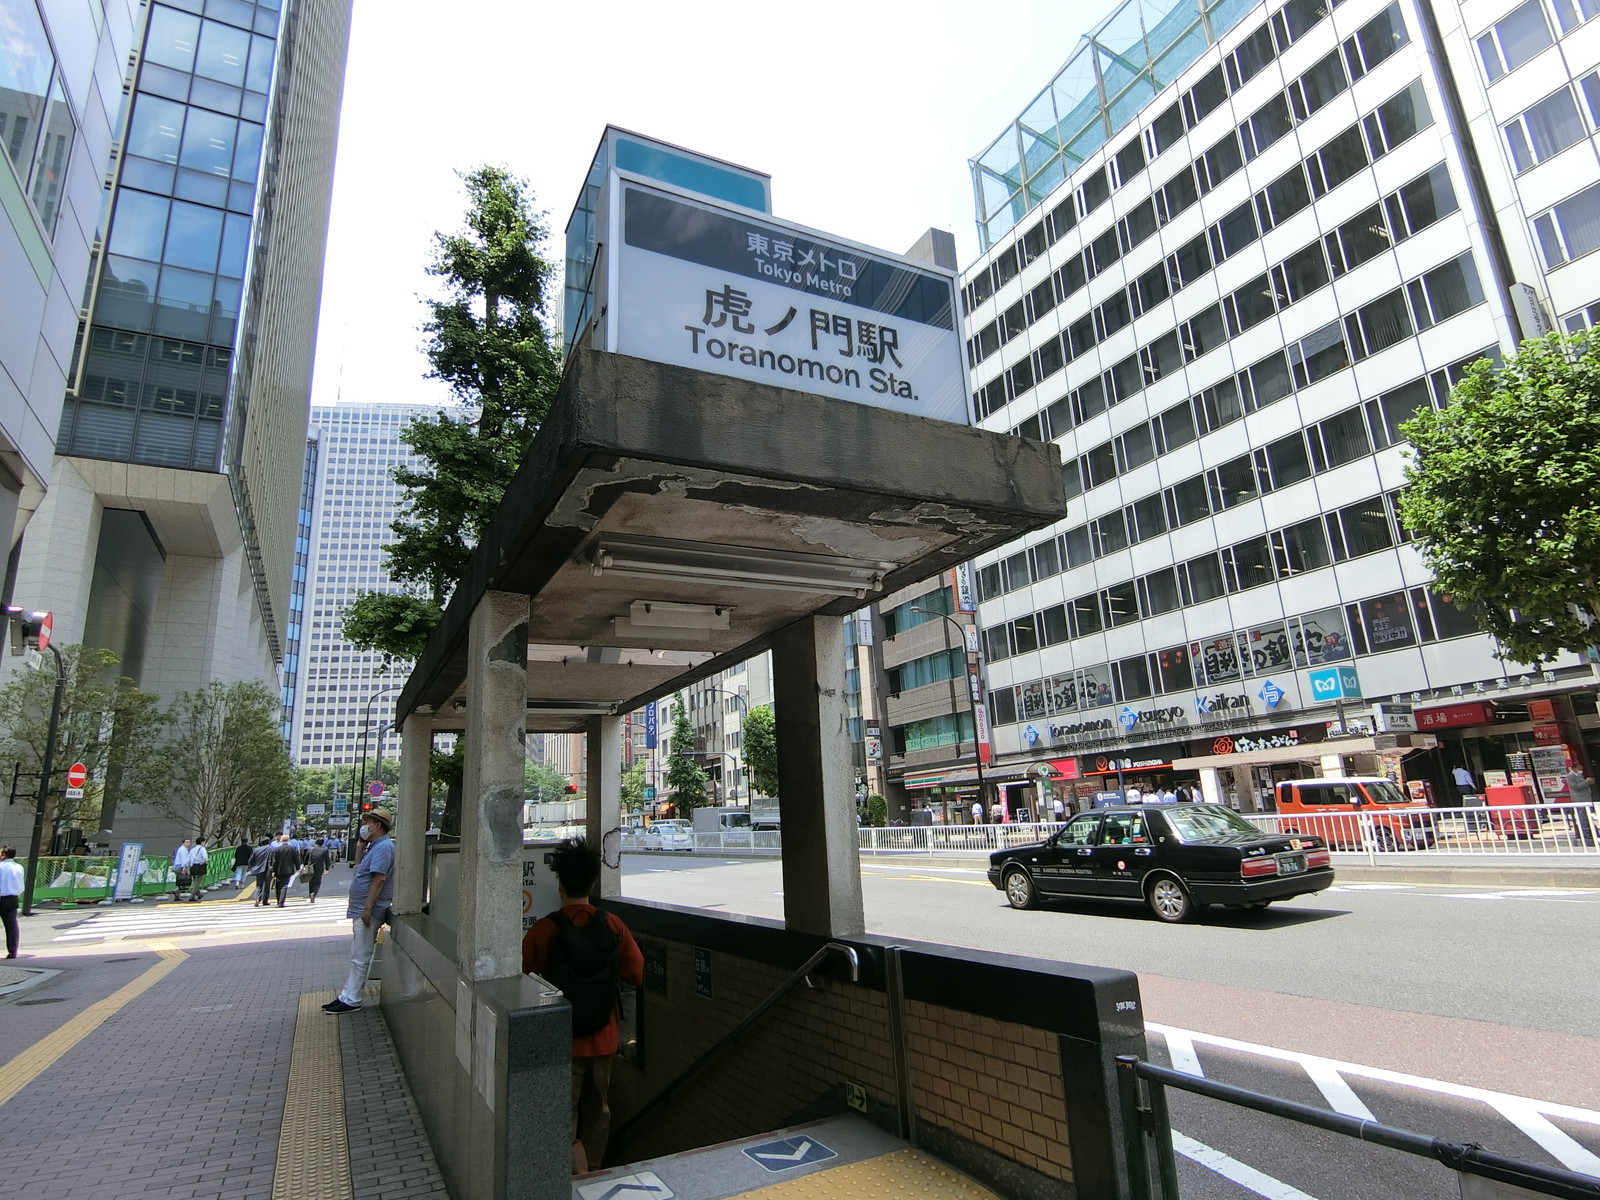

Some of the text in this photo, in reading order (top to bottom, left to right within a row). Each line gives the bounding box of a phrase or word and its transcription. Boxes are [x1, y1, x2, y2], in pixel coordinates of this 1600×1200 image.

[746, 231, 858, 281] 東京メトロ
[754, 257, 852, 297] Tokyo Metro
[702, 283, 904, 369] 虎ノ門駅
[684, 324, 919, 401] Toranomon Sta.
[977, 707, 985, 740] docomo
[1047, 717, 1113, 739] Toranomon
[1194, 692, 1251, 716] Kaikan
[1421, 712, 1449, 726] 酒場
